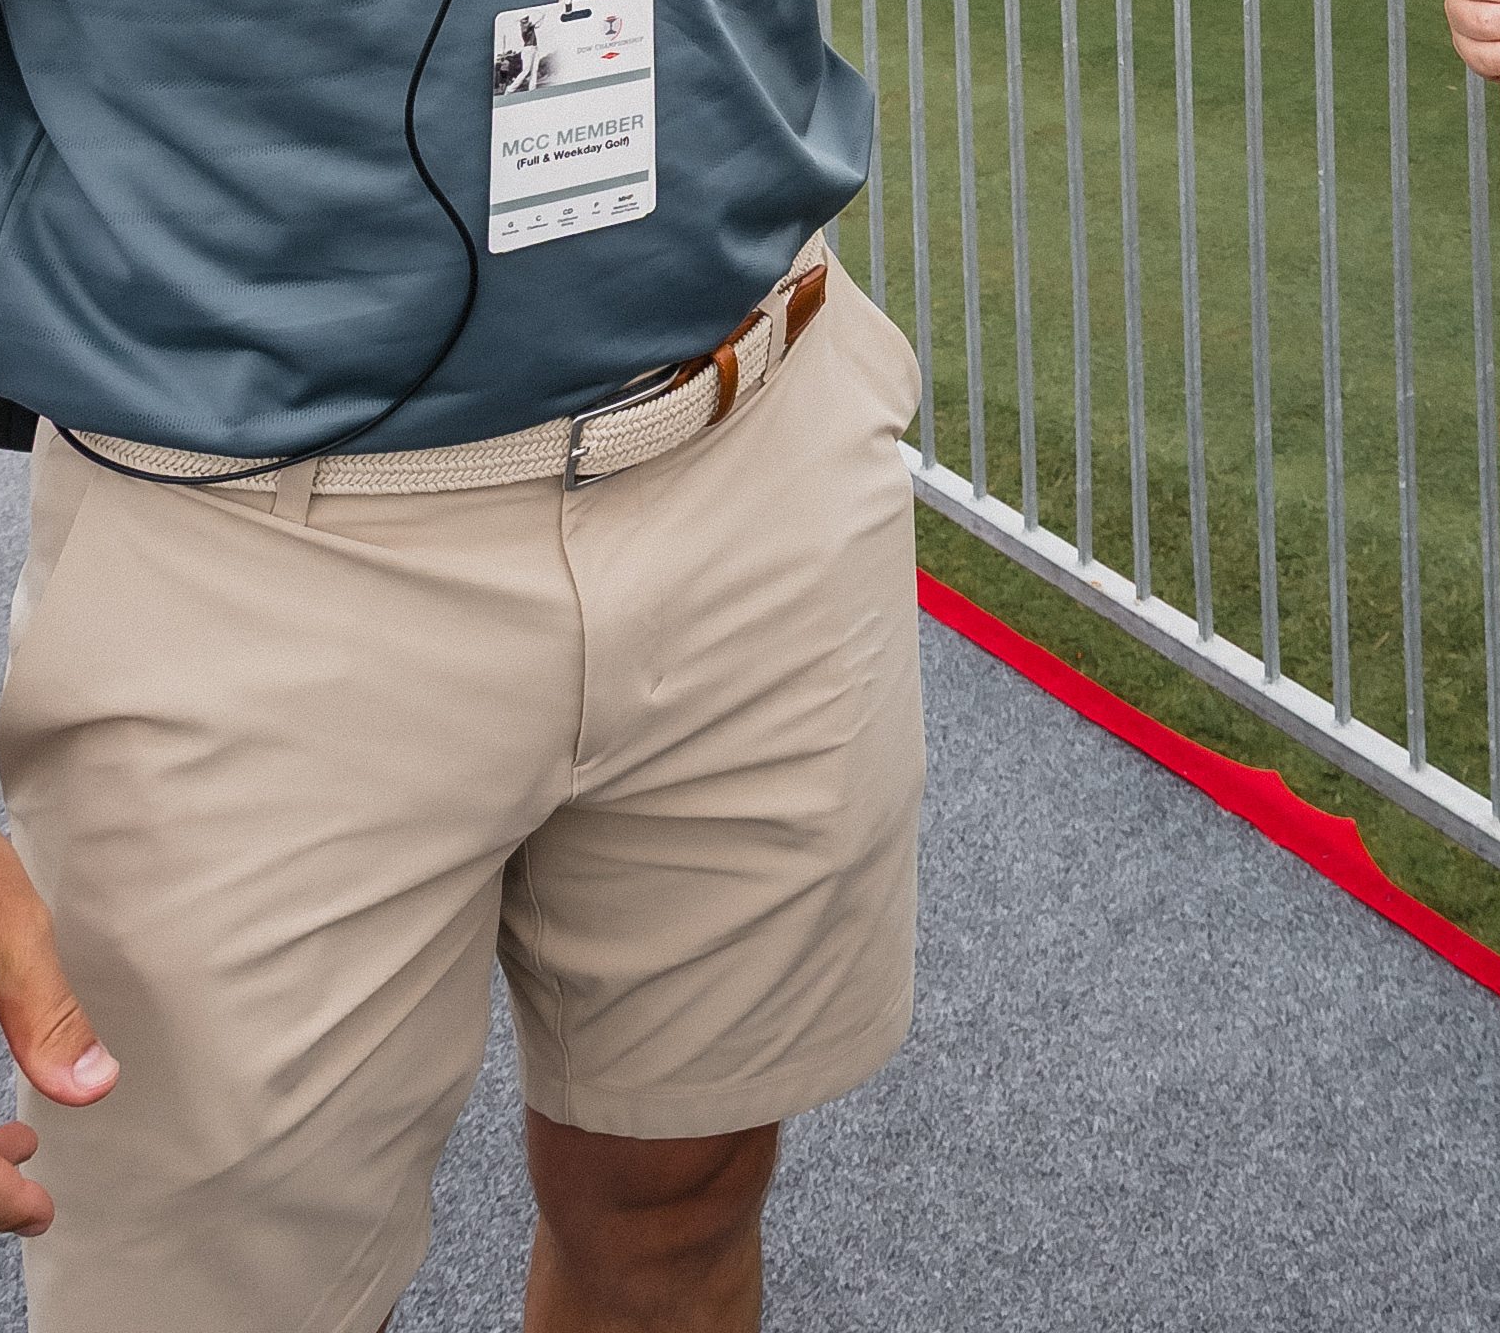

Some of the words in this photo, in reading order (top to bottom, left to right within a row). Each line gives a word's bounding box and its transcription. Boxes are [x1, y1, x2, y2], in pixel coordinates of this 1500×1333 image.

[502, 134, 550, 158] MCC
[557, 114, 645, 146] MEMBER
[543, 153, 551, 163] &
[554, 143, 602, 161] Weekday
